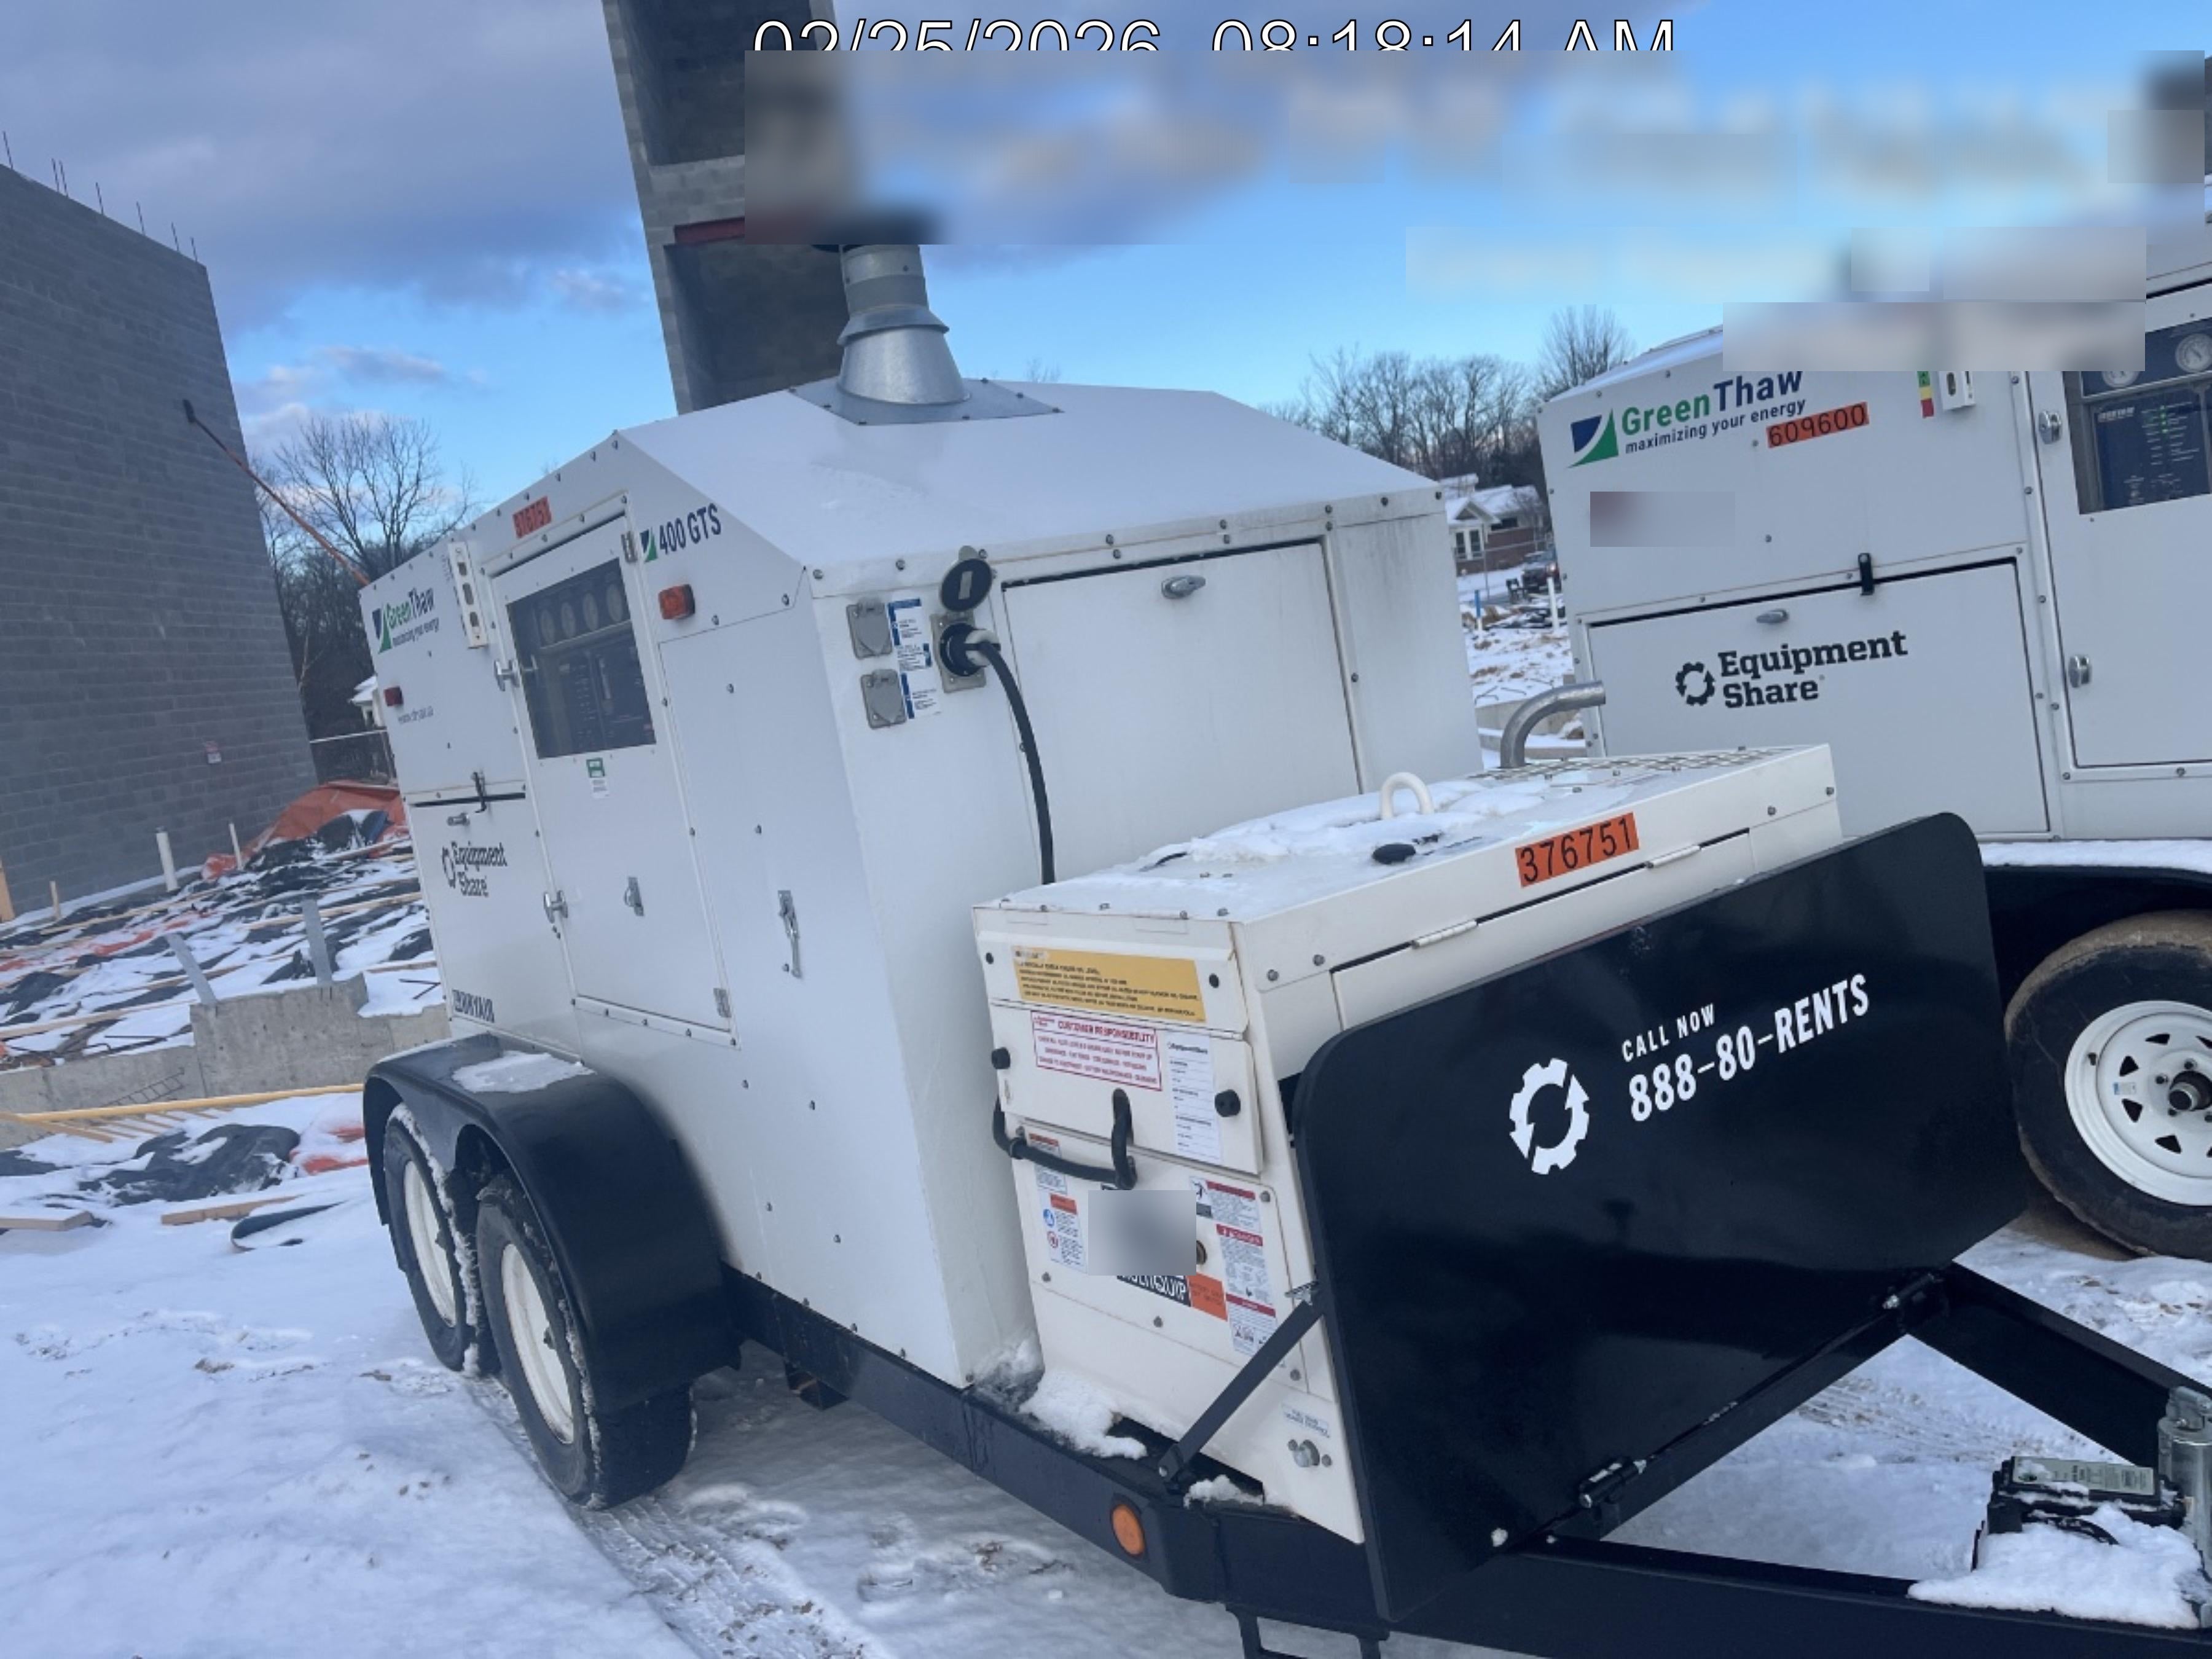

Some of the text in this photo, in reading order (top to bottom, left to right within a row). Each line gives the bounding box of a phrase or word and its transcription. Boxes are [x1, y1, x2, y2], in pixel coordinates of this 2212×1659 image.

[1622, 371, 1803, 436] GreenThaw
[1625, 398, 1806, 454] maximizing your energy
[1768, 403, 1867, 447] 609600
[659, 503, 721, 554] 400 GTS
[386, 587, 434, 630] GreenThaw
[1717, 630, 1908, 680] Equipment
[1723, 680, 1819, 709] Share
[455, 840, 508, 872] Equipment
[1520, 817, 1631, 882] 376751
[457, 871, 489, 898] Share
[1622, 1003, 1716, 1062] CALL NOW
[1628, 973, 1869, 1122] 888-80-RENTS
